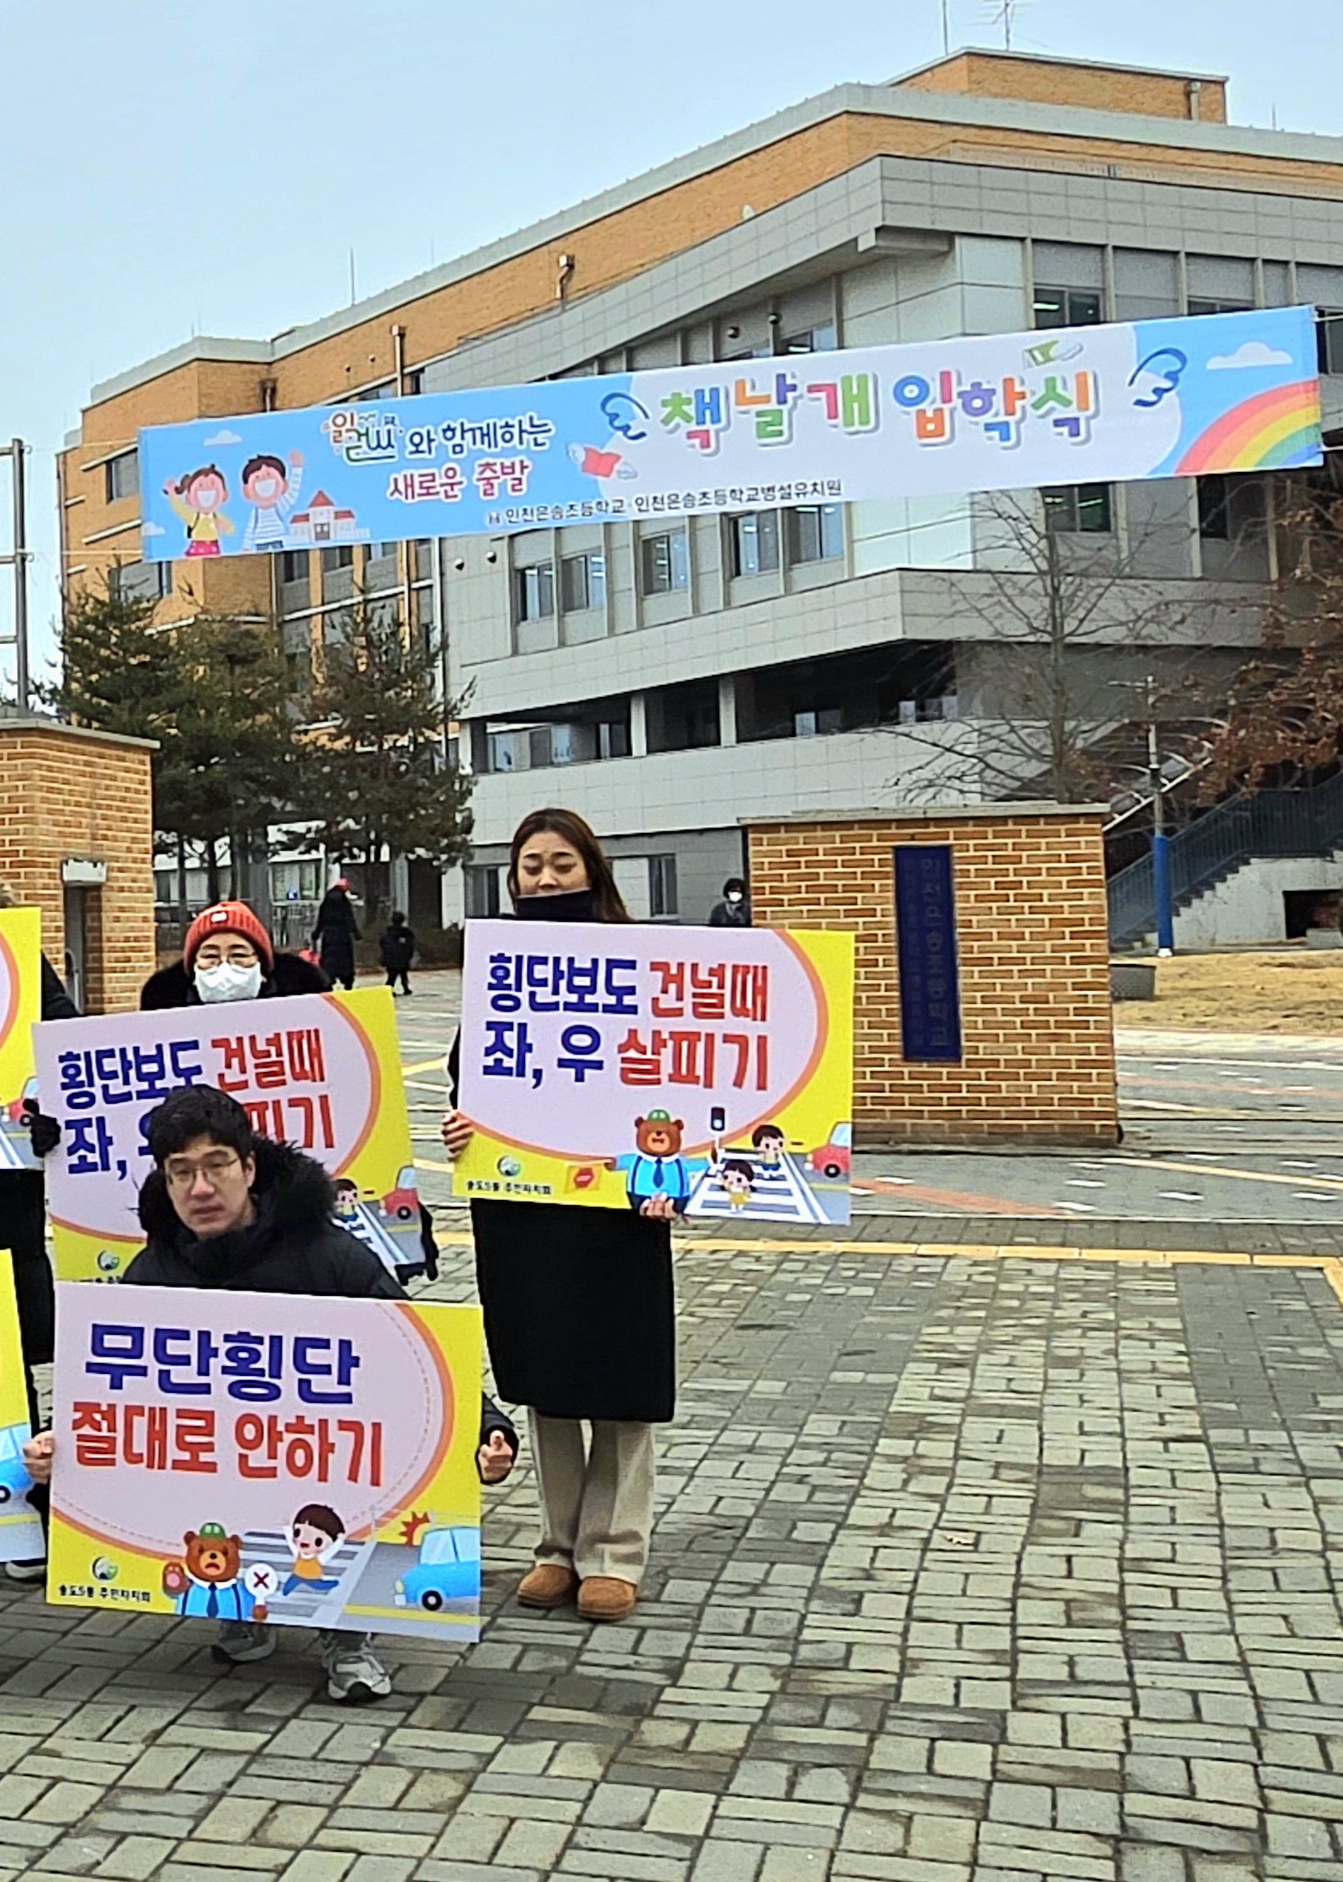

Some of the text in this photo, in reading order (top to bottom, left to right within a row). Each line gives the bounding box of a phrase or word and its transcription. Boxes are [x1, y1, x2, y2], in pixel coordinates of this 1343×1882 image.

[409, 429, 436, 456] 와
[442, 415, 552, 455] 함께하는
[661, 371, 1090, 451] 책날개 입학식
[389, 459, 529, 500] 새로운 출발
[487, 953, 769, 1022] 횡단보도 건널때
[58, 1028, 326, 1109] 횡단보도 건널때
[482, 1020, 769, 1091] 좌, 우 살피기
[65, 1117, 127, 1180] 좌,
[245, 1094, 336, 1150] 피기
[85, 1323, 360, 1405] 무단횡단
[71, 1402, 382, 1487] 절대로 안하기
